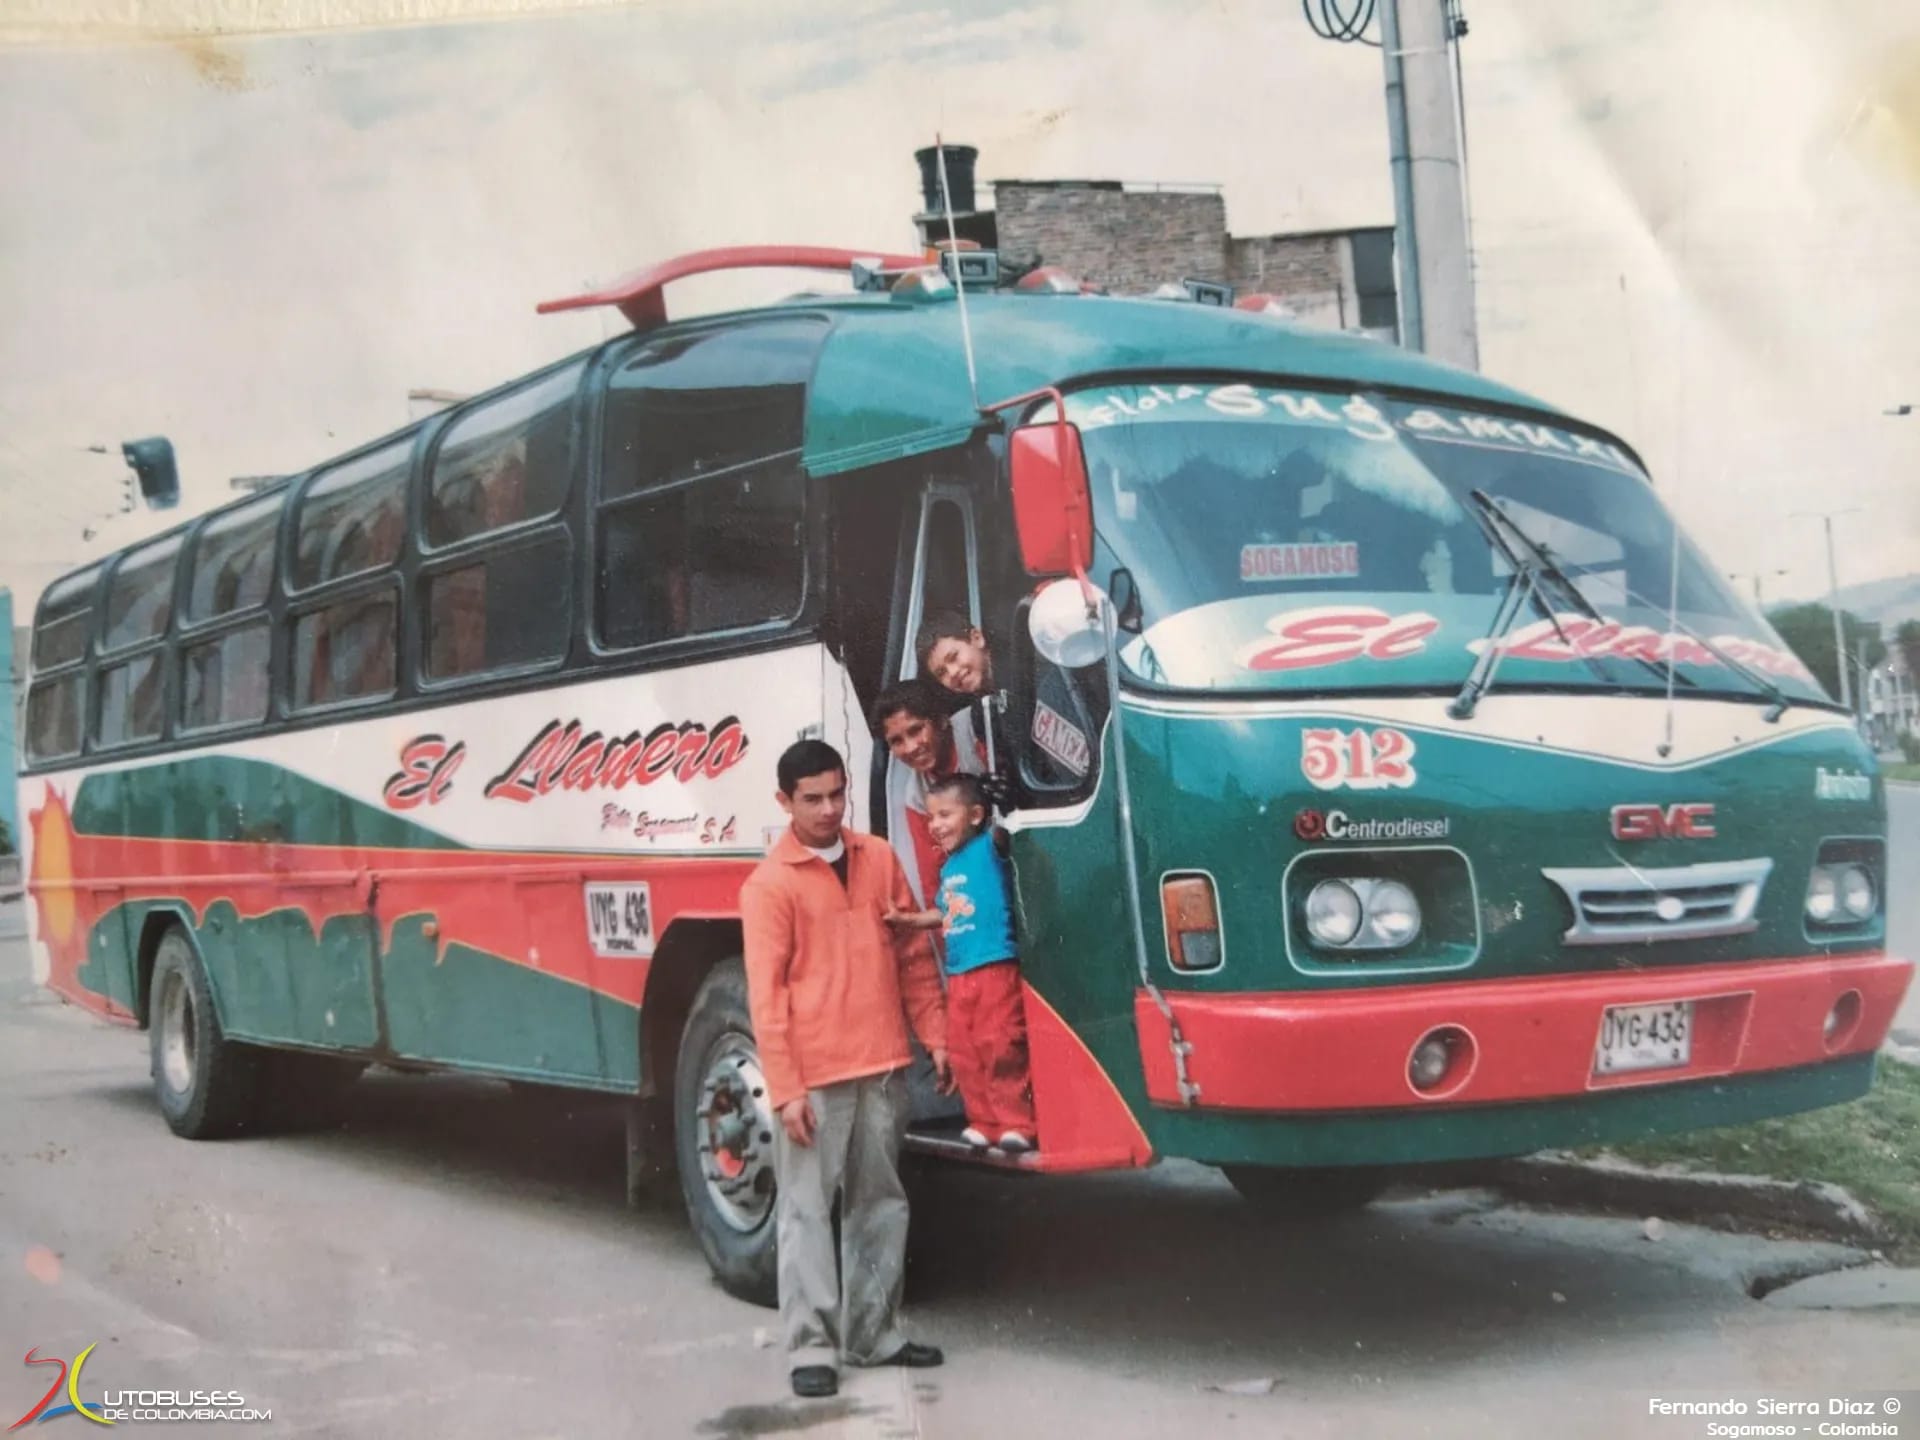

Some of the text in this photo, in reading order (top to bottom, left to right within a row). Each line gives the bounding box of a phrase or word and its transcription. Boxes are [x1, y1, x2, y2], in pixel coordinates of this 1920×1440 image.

[1241, 544, 1358, 578] SOGAMOSO
[1234, 605, 1440, 671] El
[383, 715, 750, 809] El Llanero
[1301, 728, 1416, 790] 512
[1325, 810, 1450, 839] Centrodiesel
[1611, 803, 1718, 840] GMC
[590, 890, 649, 937] UYG 436
